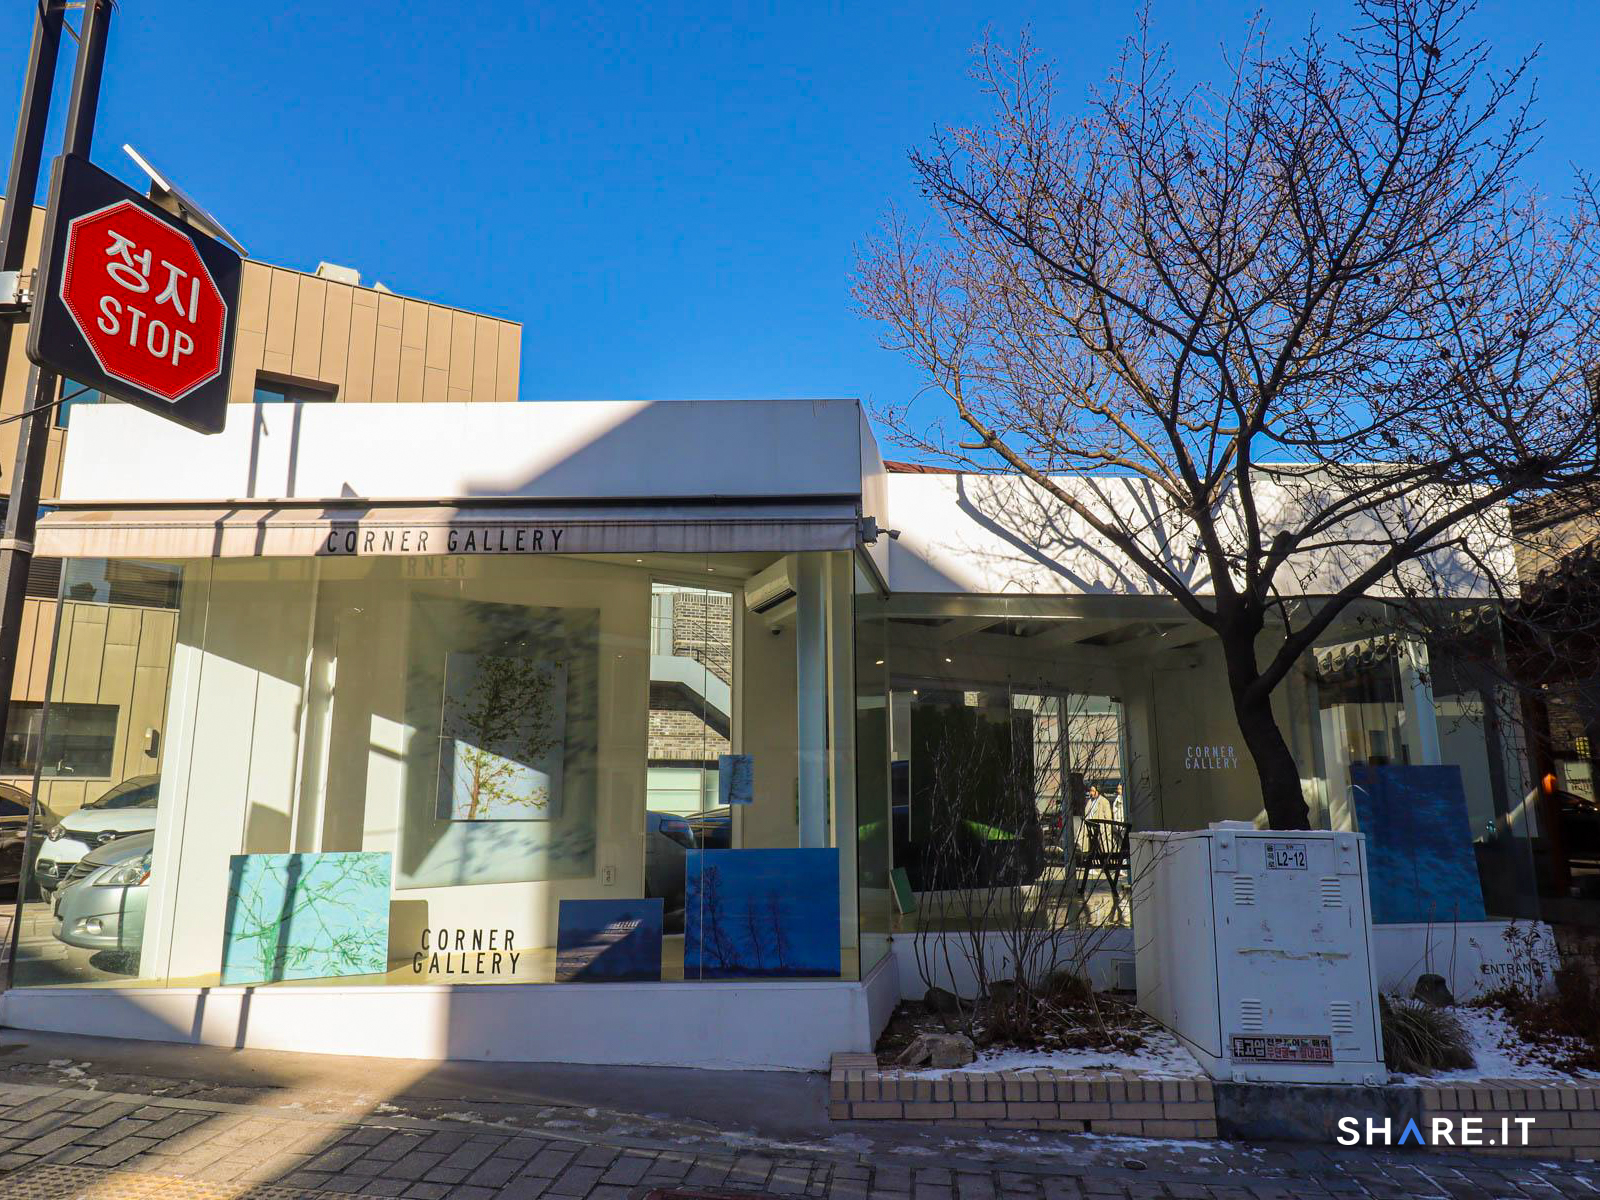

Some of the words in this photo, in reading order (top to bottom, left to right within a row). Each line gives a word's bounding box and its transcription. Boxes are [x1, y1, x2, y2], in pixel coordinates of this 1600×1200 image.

[105, 229, 200, 324] 정지
[97, 295, 194, 366] STOP
[327, 530, 429, 552] CORNER
[447, 529, 563, 551] GALLERY
[406, 557, 467, 577] RNER
[1187, 745, 1235, 758] CORNER
[1184, 757, 1238, 769] GALLERY
[1276, 851, 1305, 866] L2-12
[421, 928, 515, 950] CORNER
[412, 951, 520, 974] GALLERY
